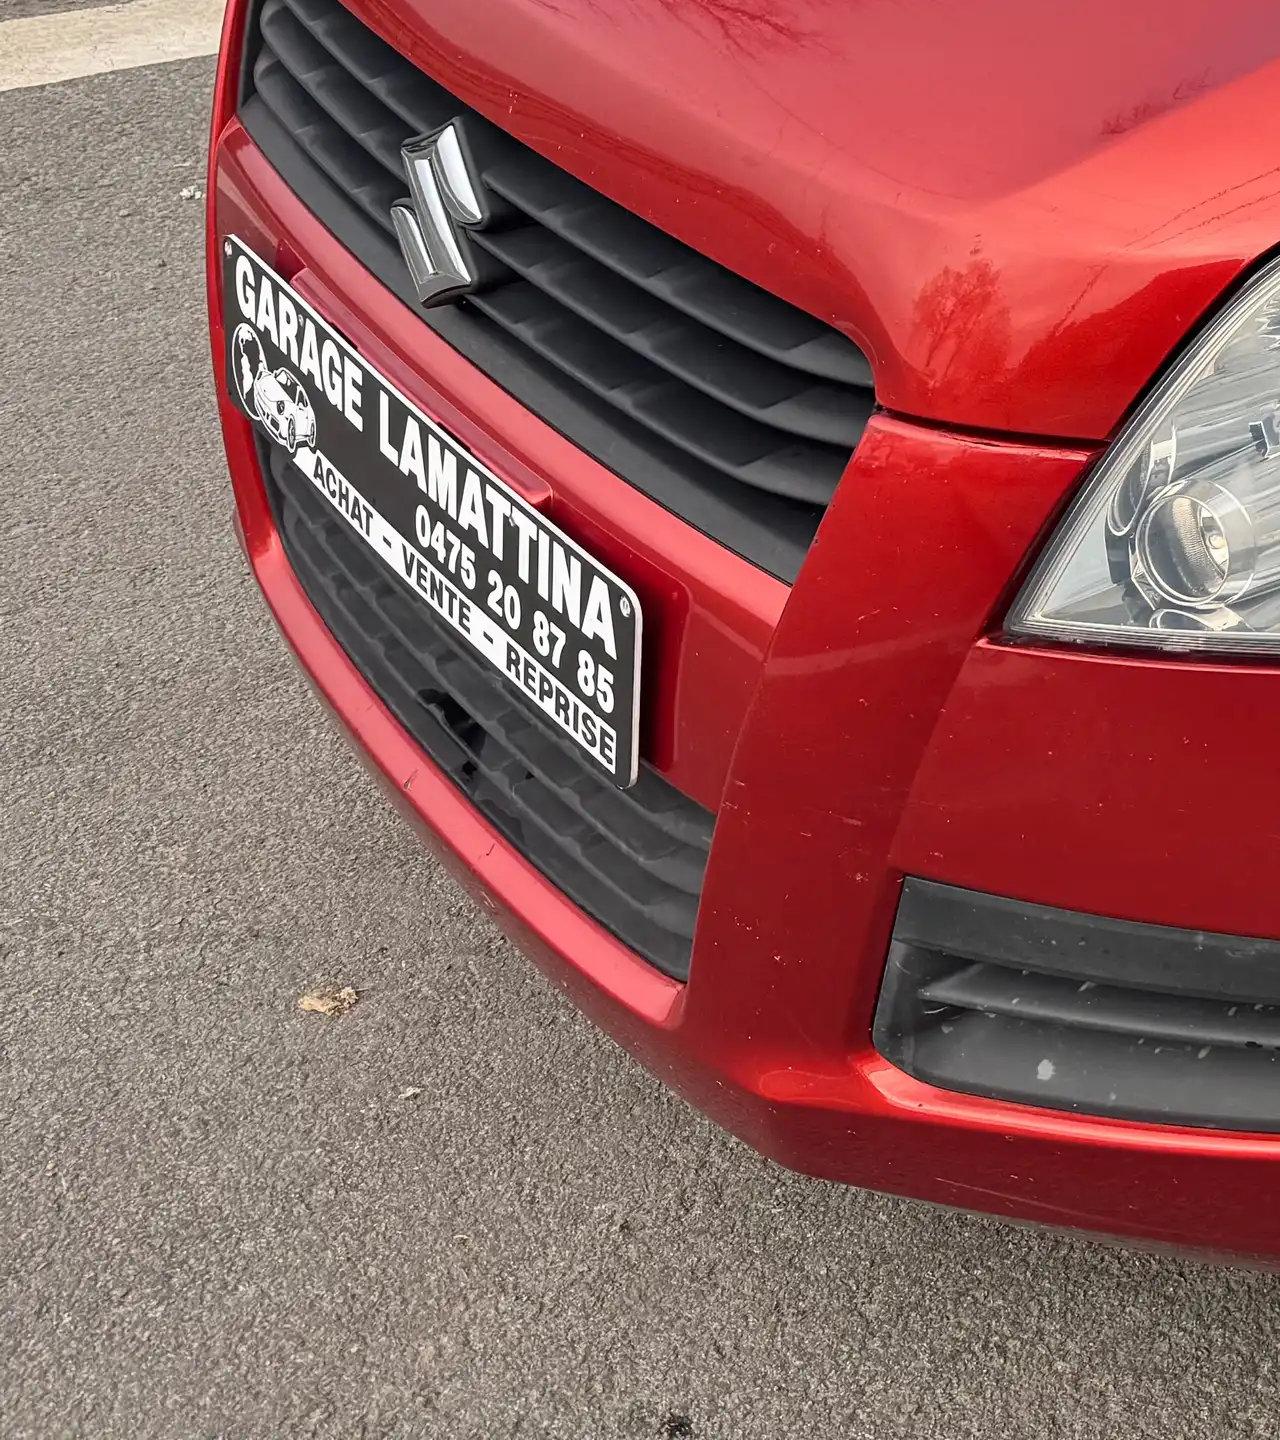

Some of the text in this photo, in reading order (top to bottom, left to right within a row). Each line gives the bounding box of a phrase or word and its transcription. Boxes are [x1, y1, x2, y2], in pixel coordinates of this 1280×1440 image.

[235, 254, 618, 660] GARAGE LAMATTINA
[313, 455, 374, 535] ACHAT
[401, 543, 472, 634] VENTE
[506, 639, 615, 766] REPRISE
[415, 504, 615, 714] 0475 20 87 85
